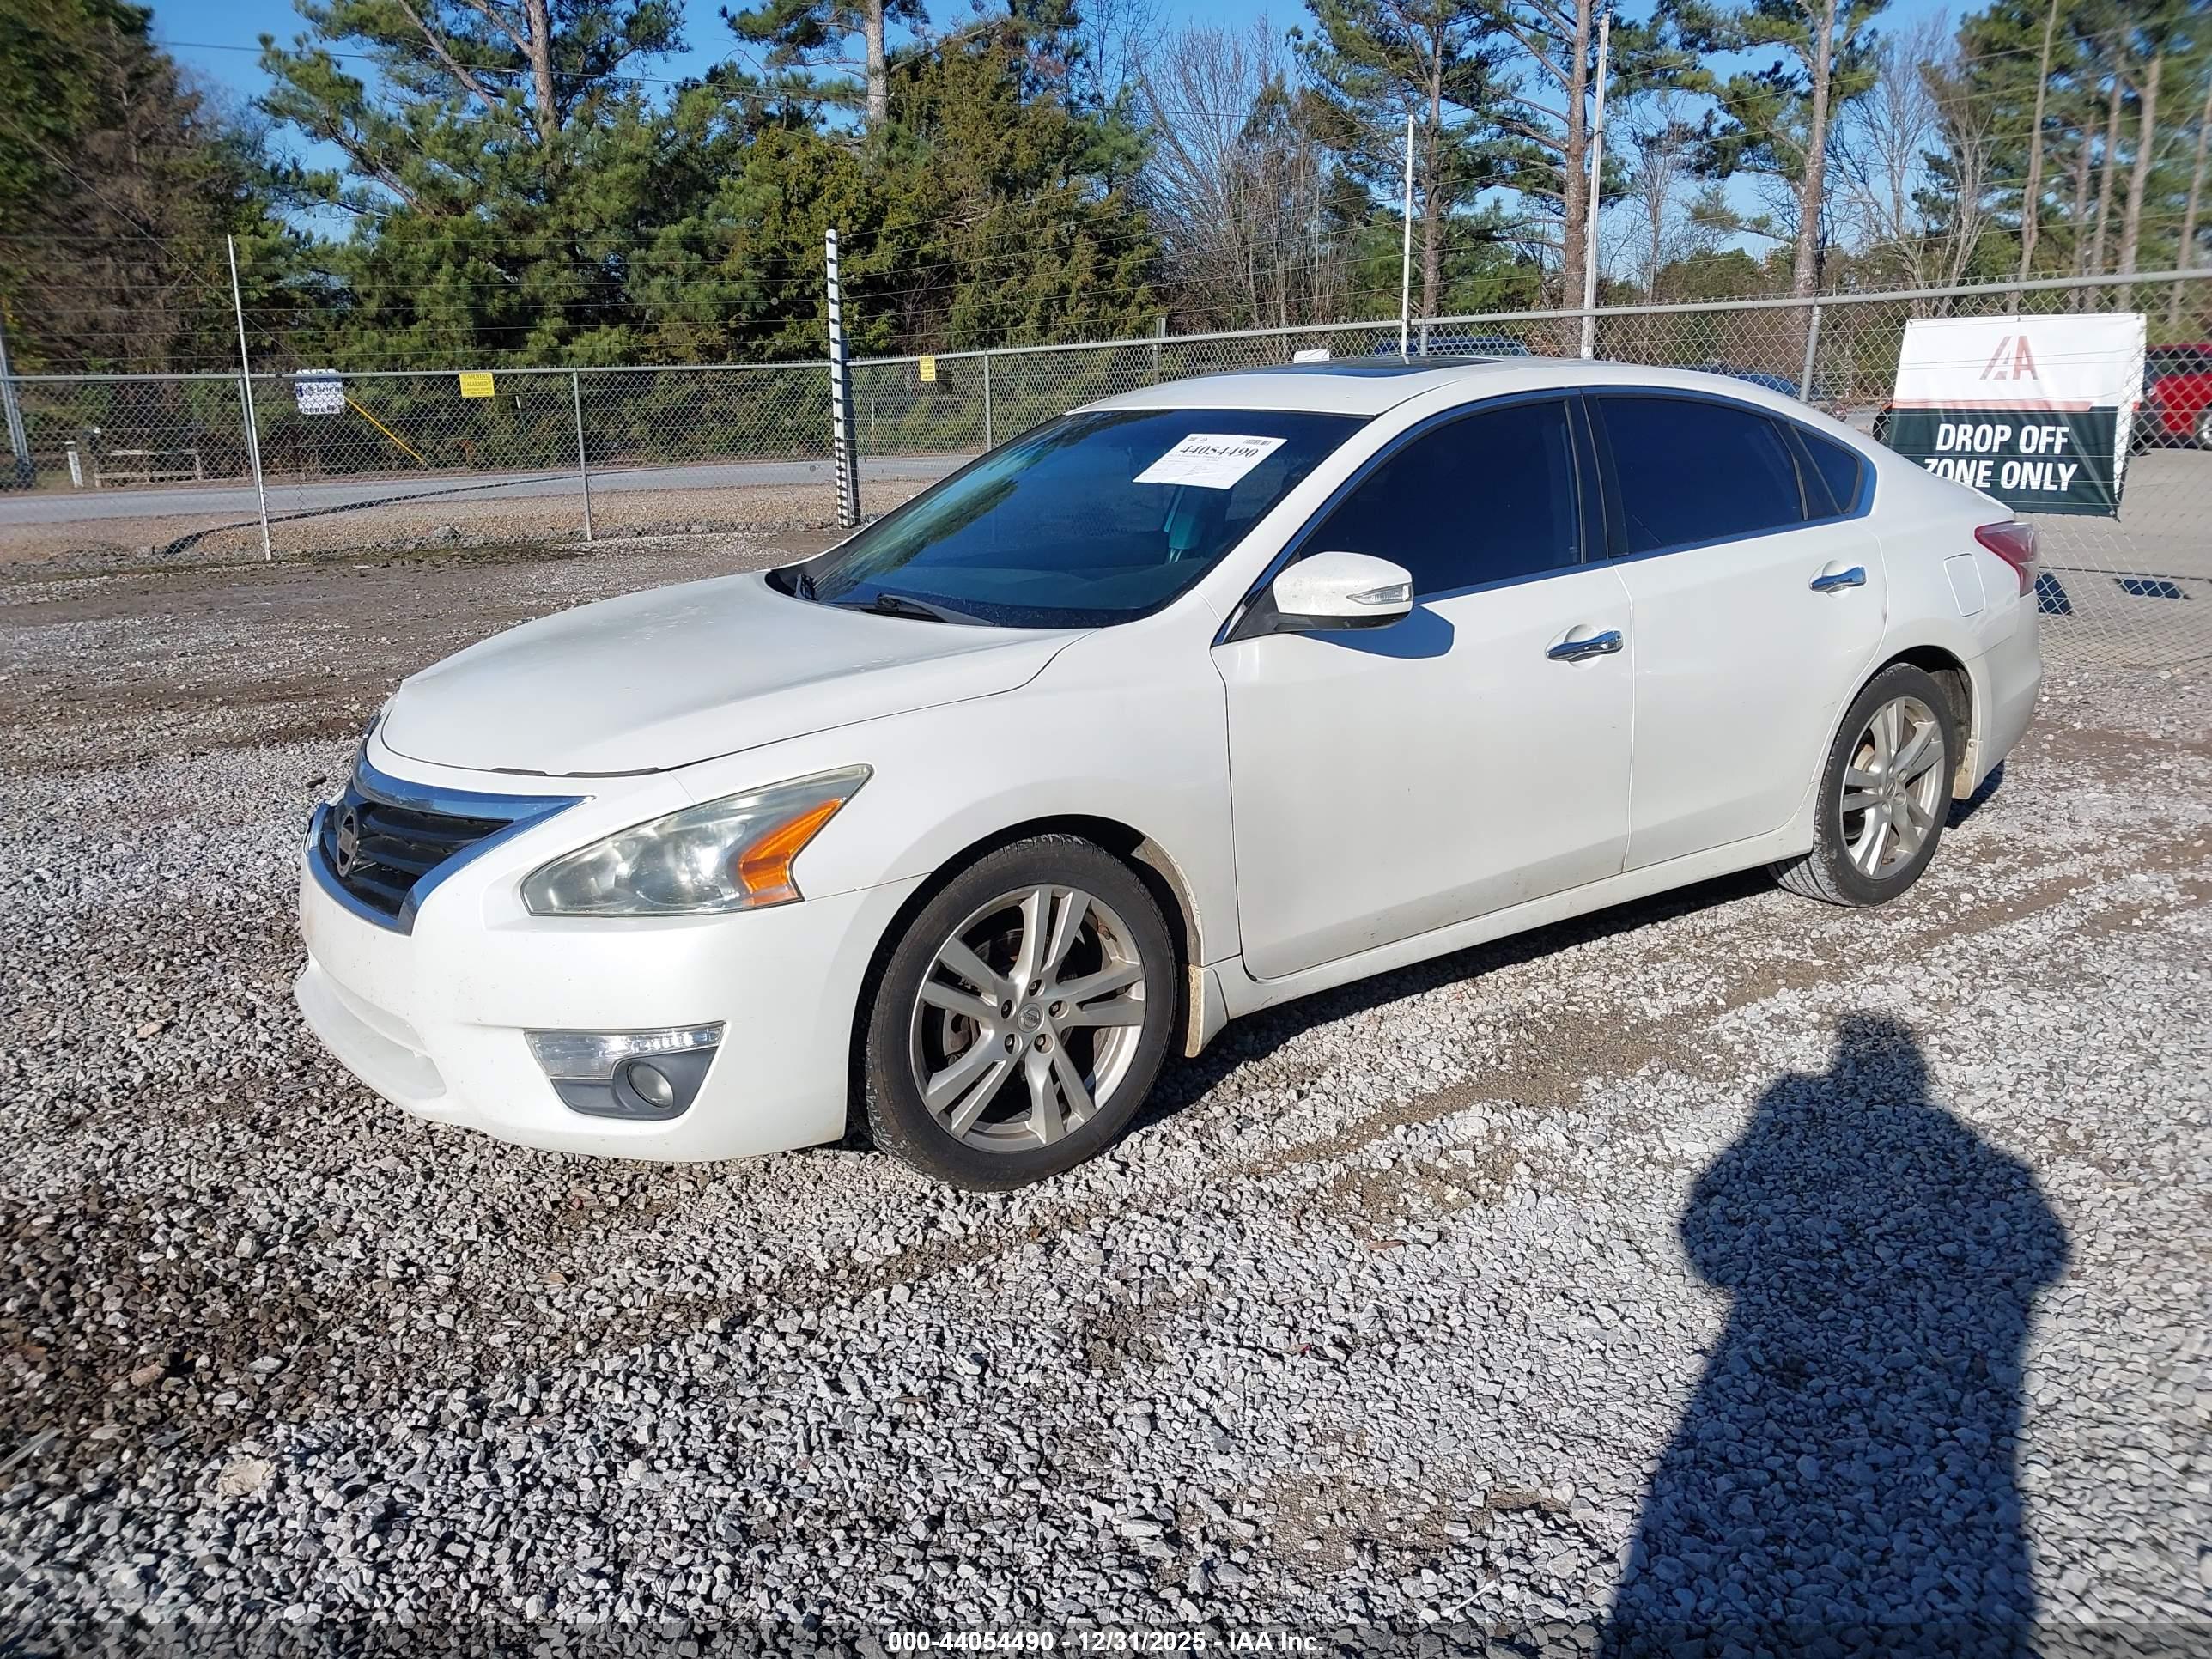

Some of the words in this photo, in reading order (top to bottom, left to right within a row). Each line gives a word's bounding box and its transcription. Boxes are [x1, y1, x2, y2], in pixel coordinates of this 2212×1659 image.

[1179, 444, 1260, 459] 44054490
[1936, 423, 2012, 453] DROP
[2019, 424, 2070, 455] OFF
[1923, 458, 1995, 488] ZONE
[2000, 460, 2078, 492] ONLY
